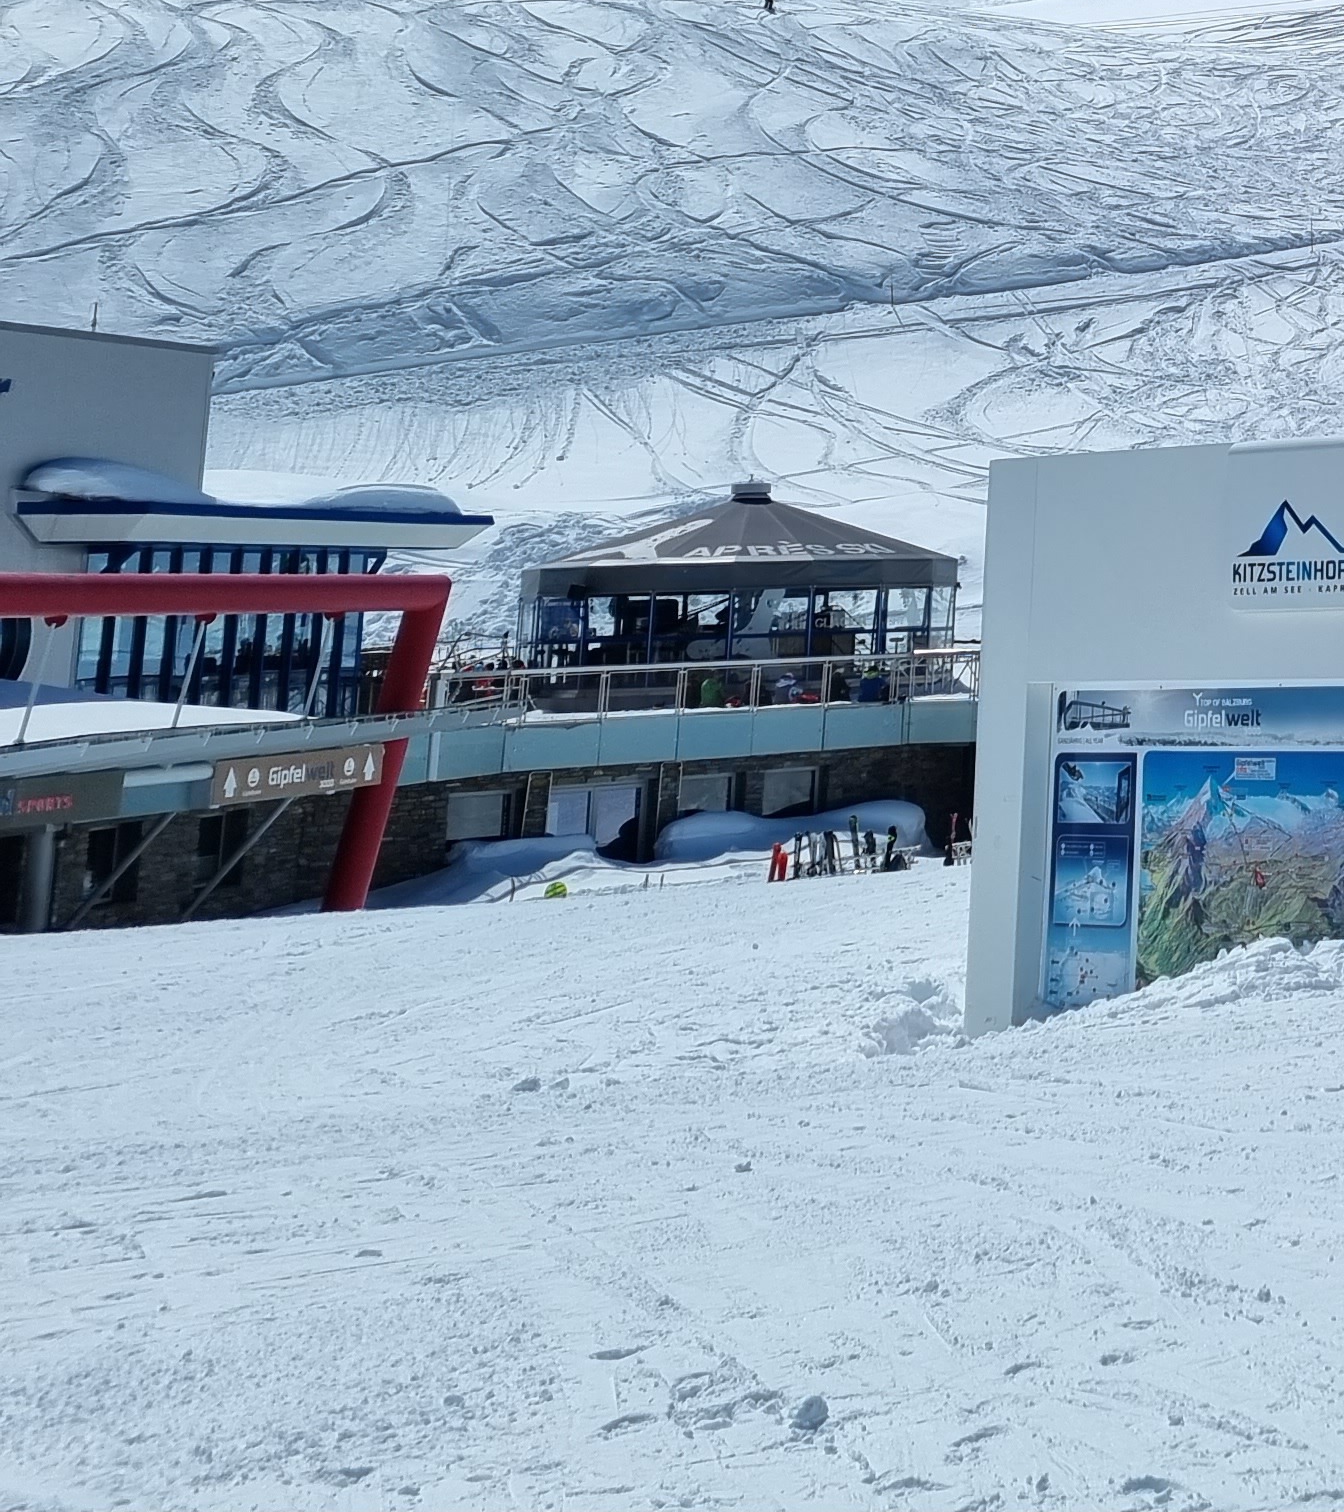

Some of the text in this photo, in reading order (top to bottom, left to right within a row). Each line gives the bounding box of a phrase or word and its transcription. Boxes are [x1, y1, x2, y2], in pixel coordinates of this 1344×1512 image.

[682, 540, 896, 558] APRÈS SKI
[1233, 587, 1257, 595] ZELL
[1263, 586, 1277, 595] AM
[1284, 585, 1302, 594] SEE
[1184, 709, 1262, 730] Gipfelwelt
[268, 761, 335, 788] Gipfelwelt
